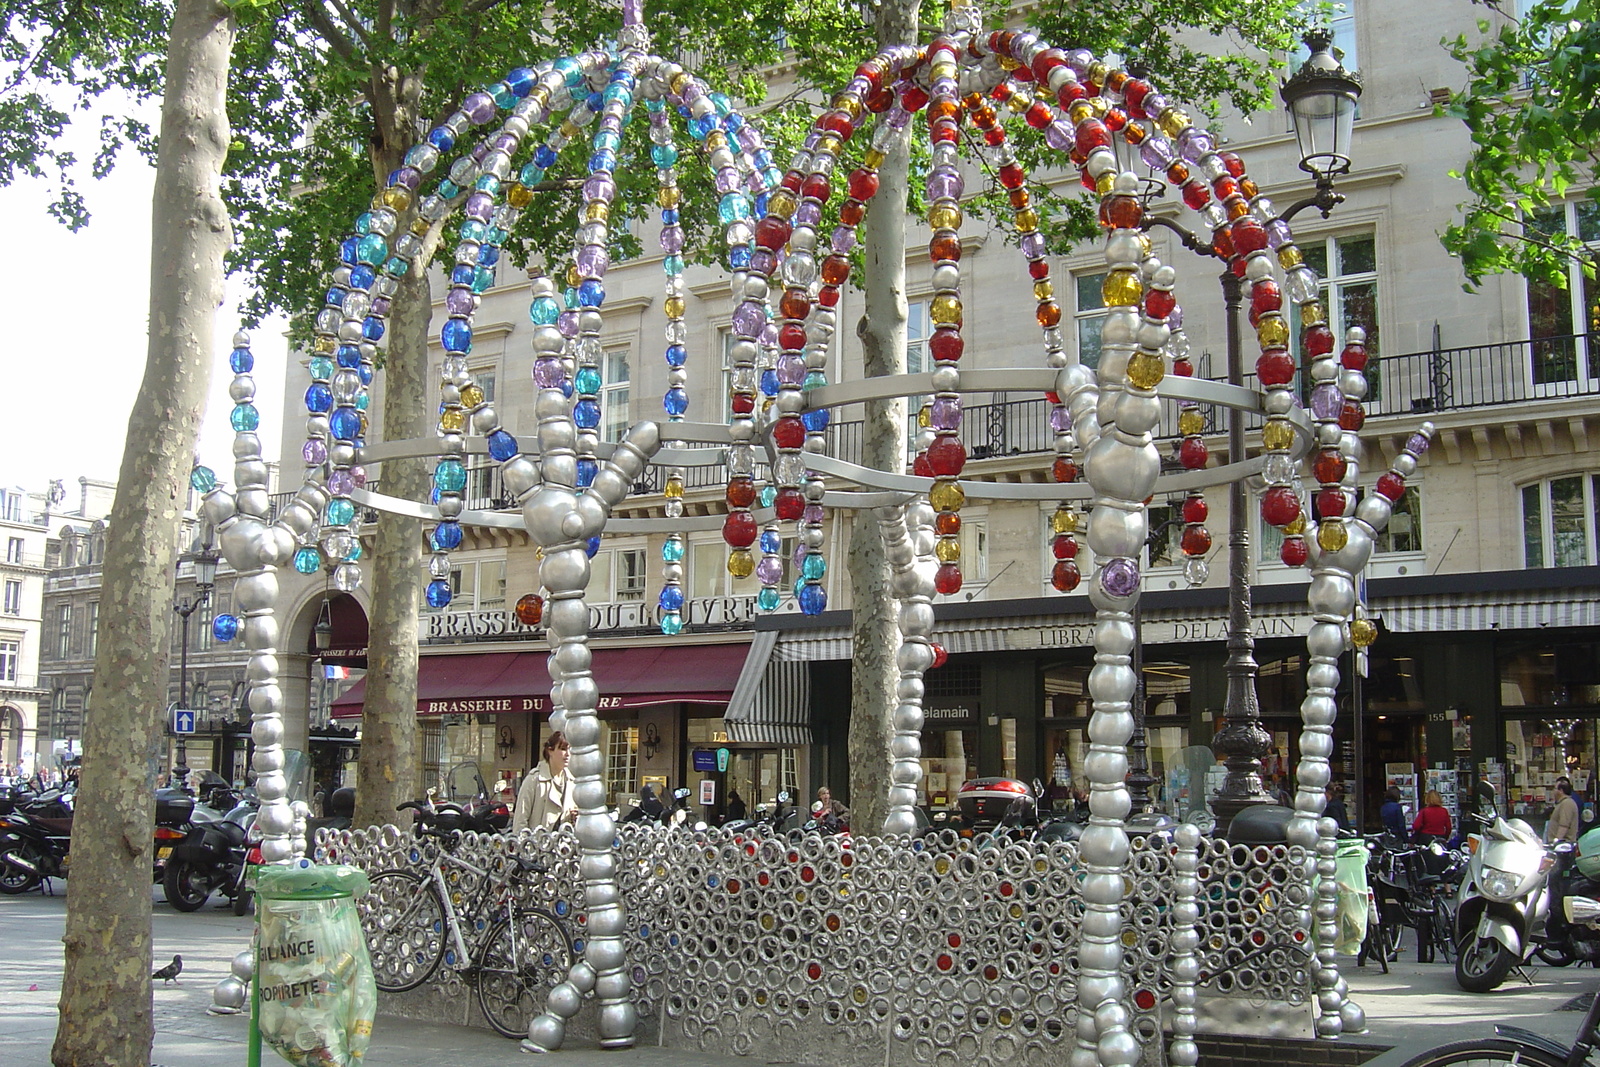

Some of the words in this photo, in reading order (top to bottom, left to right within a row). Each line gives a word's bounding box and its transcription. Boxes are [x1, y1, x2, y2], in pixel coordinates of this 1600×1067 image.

[588, 603, 622, 630] DU
[1039, 627, 1094, 646] LIBRA
[1174, 617, 1297, 640] DELAAIN
[428, 699, 512, 713] BRASSERIE
[523, 698, 544, 711] DU
[922, 705, 969, 719] elamain
[1428, 712, 1445, 722] 155
